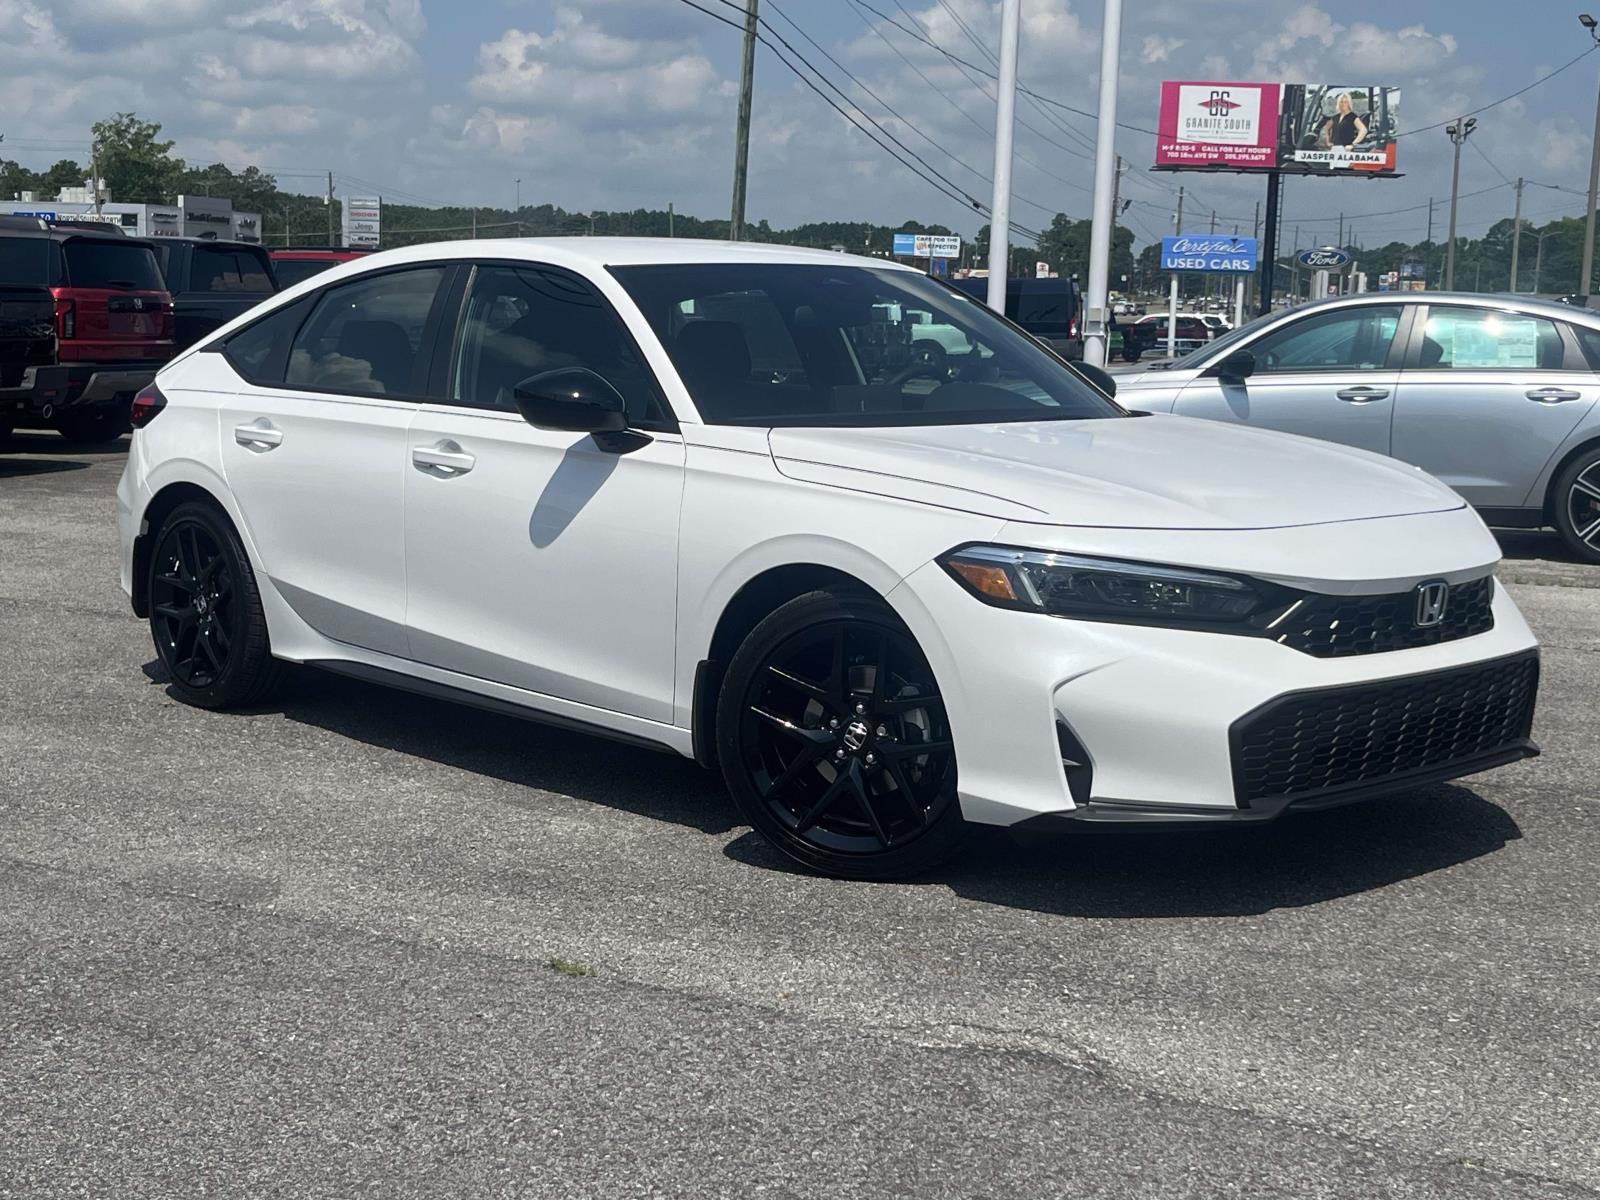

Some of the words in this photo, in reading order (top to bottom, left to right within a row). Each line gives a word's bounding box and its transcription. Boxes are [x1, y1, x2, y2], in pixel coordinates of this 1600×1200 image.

[1186, 117, 1221, 129] GRANITE
[1224, 119, 1251, 131] SOUTH
[1301, 153, 1335, 161] JASPER
[1337, 154, 1380, 162] ALABAMA
[1172, 239, 1247, 257] Certified
[1167, 258, 1206, 269] USED
[1210, 259, 1251, 270] CARS
[1307, 252, 1338, 265] Ford
